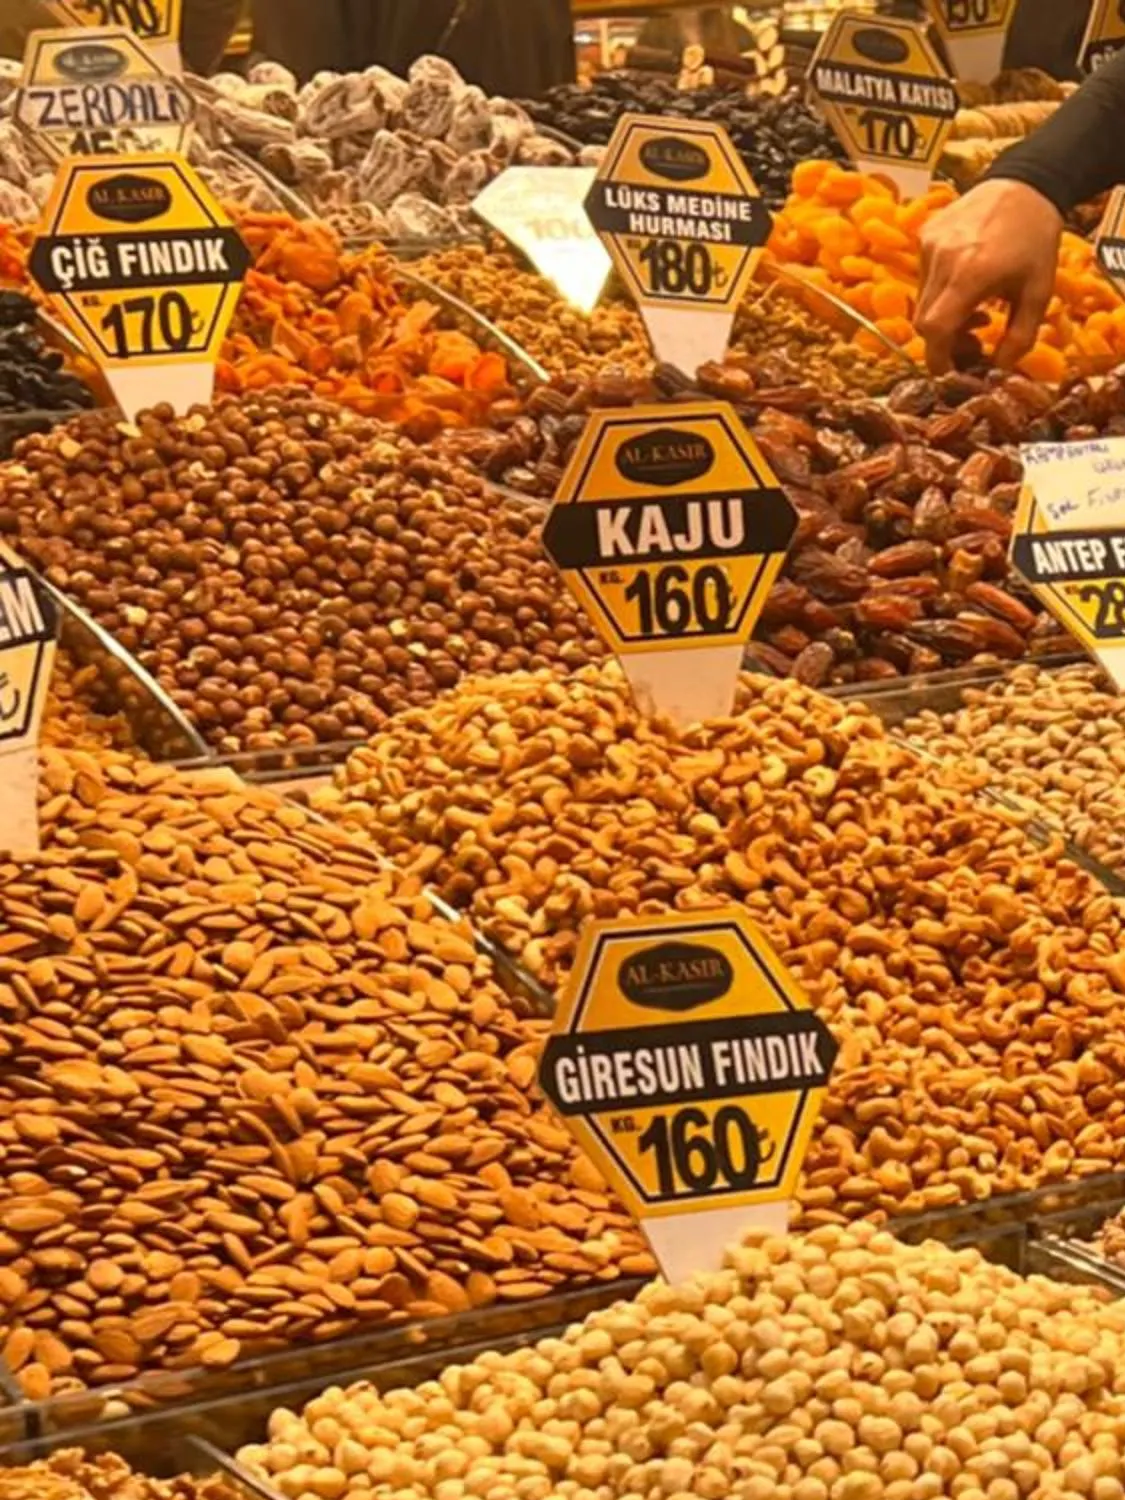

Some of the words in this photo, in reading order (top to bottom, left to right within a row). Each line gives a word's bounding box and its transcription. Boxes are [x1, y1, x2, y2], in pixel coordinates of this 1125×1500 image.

[816, 66, 896, 103] MALATYA
[604, 186, 661, 212] LÜKS
[667, 193, 752, 222] MEDİNE
[629, 212, 732, 242] HURMASI
[50, 236, 110, 289] ÇİĞ
[117, 238, 229, 277] FINDIK
[596, 497, 745, 558] KAJU
[1031, 538, 1108, 575] ANTEP
[554, 1044, 705, 1104] GİRESUN
[711, 1031, 825, 1087] FINDIK
